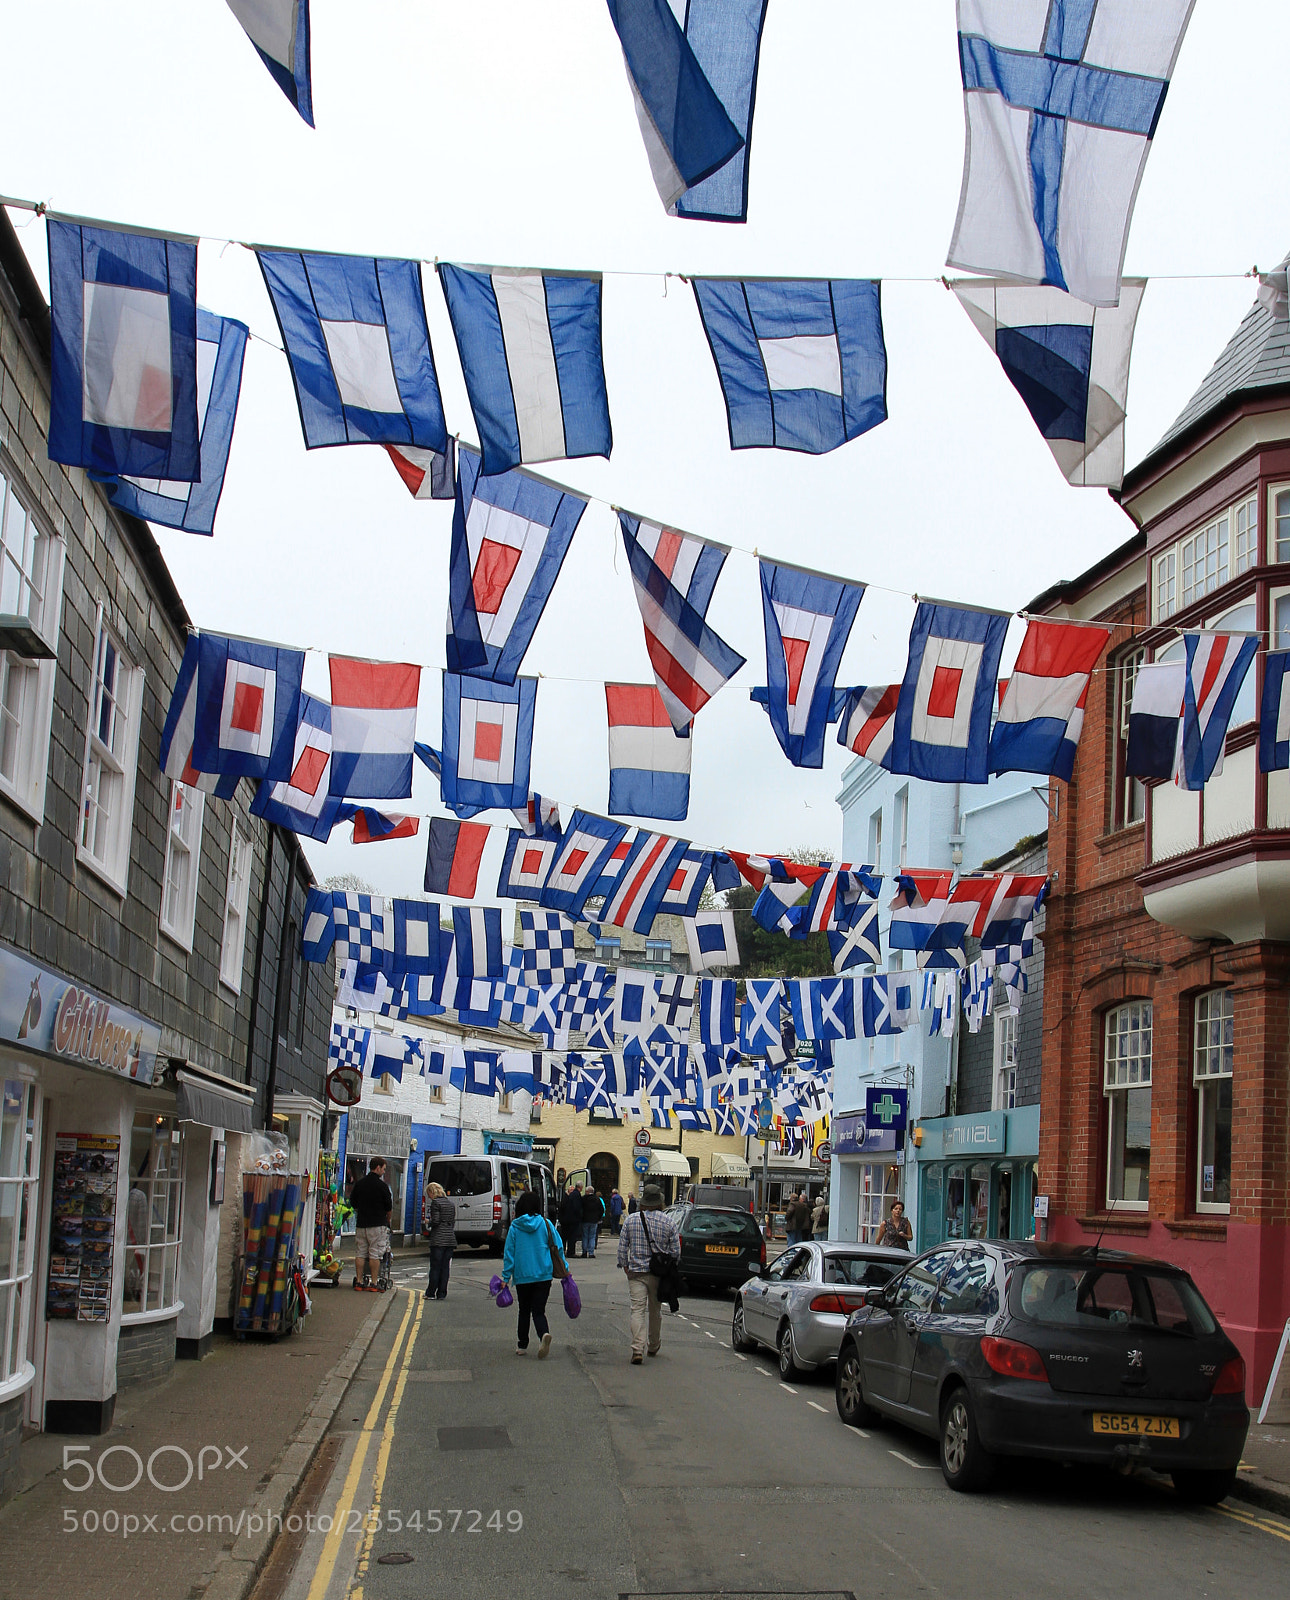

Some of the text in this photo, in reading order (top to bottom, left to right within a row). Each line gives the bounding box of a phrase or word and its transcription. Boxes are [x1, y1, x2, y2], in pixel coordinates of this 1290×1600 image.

[1049, 1353, 1090, 1364] PEUGEOT
[1199, 1364, 1217, 1372] 307
[1100, 1415, 1173, 1435] SG54 ZJX
